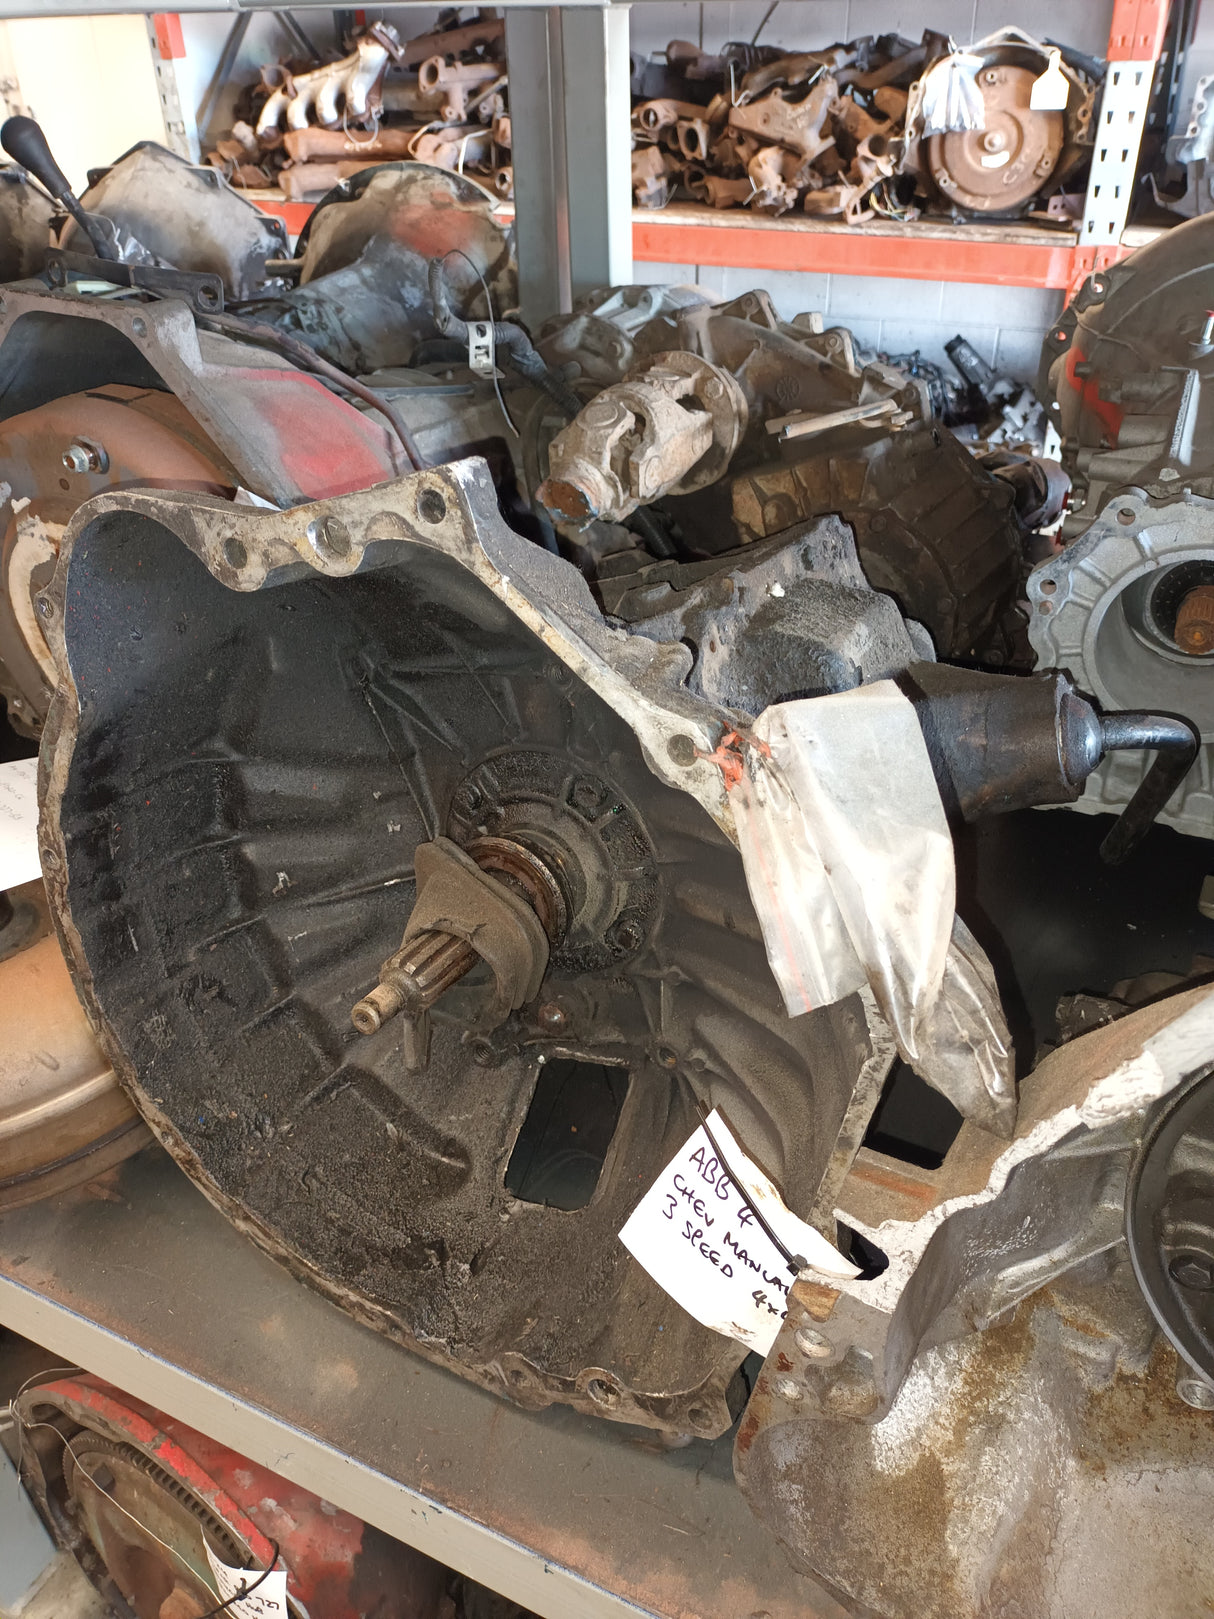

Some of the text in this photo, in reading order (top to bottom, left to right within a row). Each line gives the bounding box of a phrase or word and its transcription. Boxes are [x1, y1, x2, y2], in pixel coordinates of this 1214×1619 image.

[689, 1146, 729, 1200] ABB
[673, 1174, 715, 1227] CHEV
[662, 1194, 678, 1220] 3
[682, 1220, 734, 1279] SPEED
